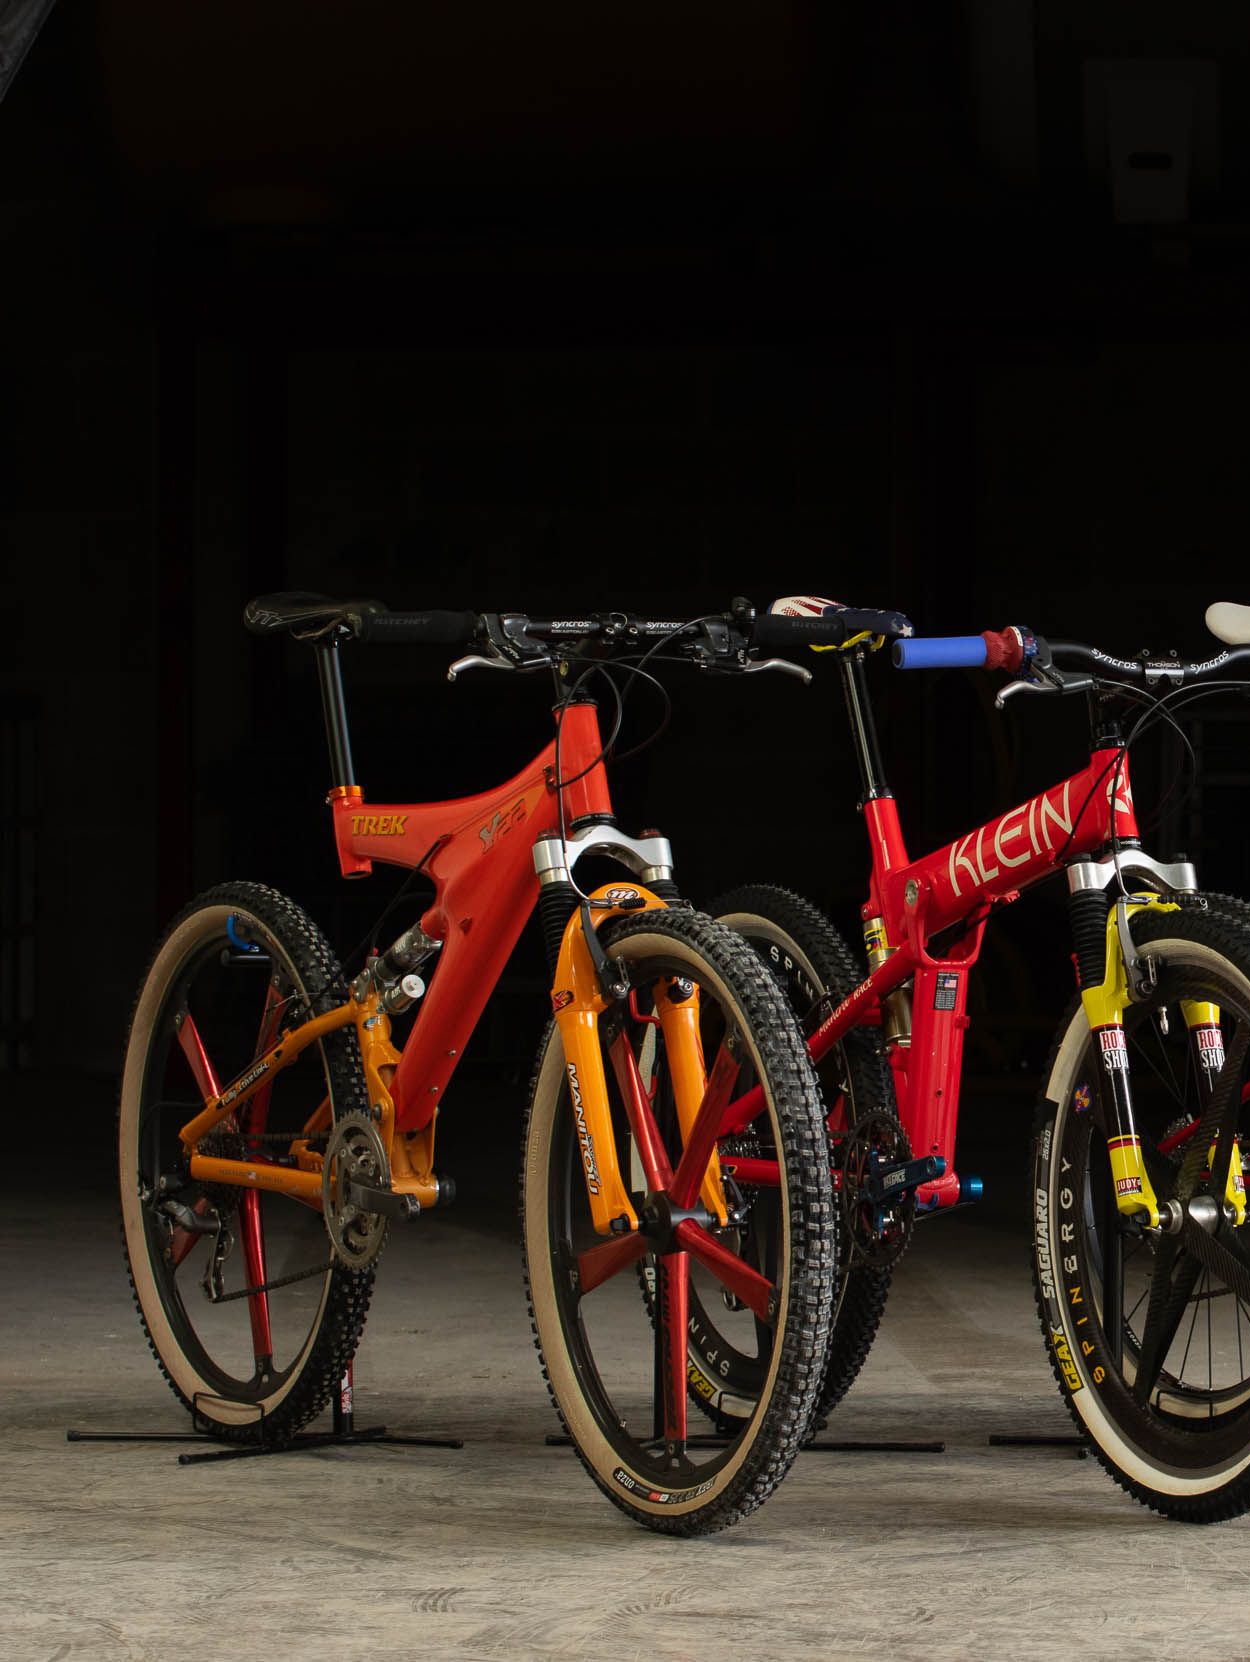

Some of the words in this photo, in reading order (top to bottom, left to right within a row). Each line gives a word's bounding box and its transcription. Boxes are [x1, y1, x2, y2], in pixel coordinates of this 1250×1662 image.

[550, 620, 592, 630] syncros
[645, 620, 685, 630] syncros
[1090, 647, 1138, 671] syncros
[1189, 650, 1231, 675] syncros
[351, 815, 409, 836] TREK
[949, 780, 1076, 897] KLEIN
[566, 1062, 599, 1195] MANITOU
[1116, 1178, 1137, 1191] JUDY
[1036, 1187, 1056, 1300] SAGUARO
[1060, 1156, 1105, 1384] SPINERGY
[1051, 1326, 1084, 1391] GEAX
[616, 1470, 636, 1490] onza
